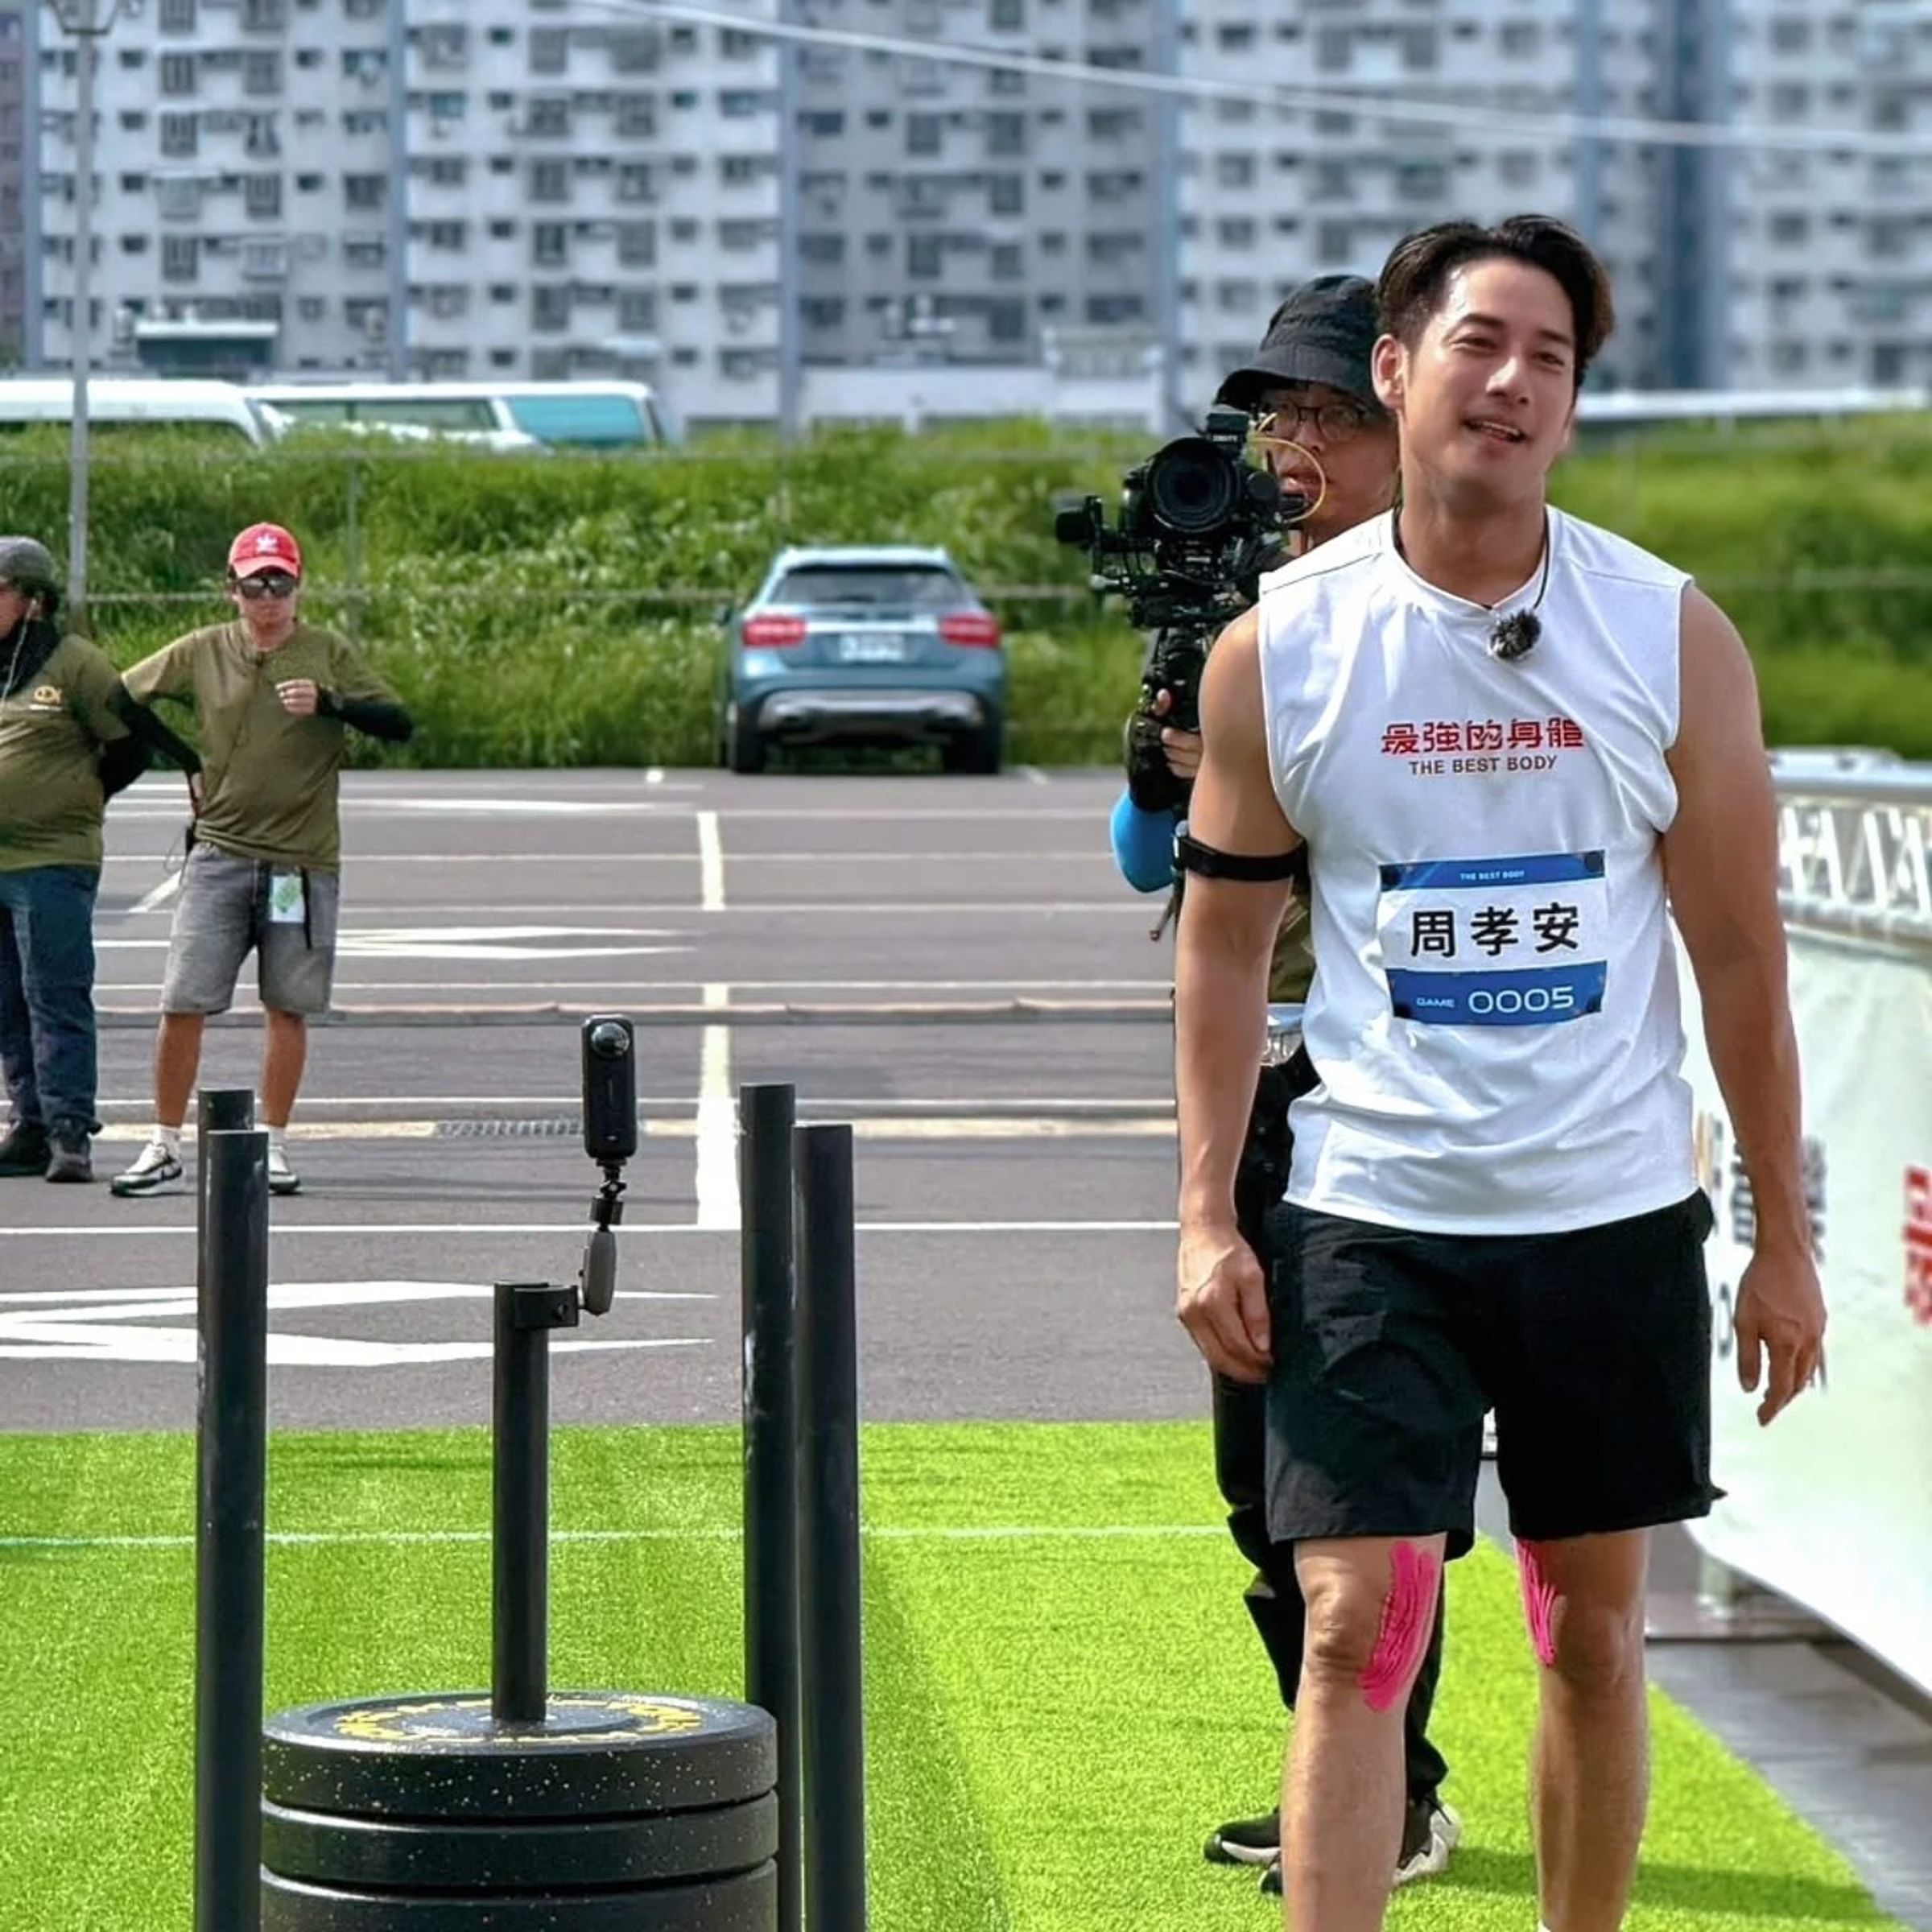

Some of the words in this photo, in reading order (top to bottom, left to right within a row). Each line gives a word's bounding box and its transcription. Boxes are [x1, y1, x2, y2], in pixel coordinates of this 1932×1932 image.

[1381, 717, 1584, 753] 最強的身體
[1409, 760, 1445, 774] THE
[1452, 758, 1500, 773] BEST
[1507, 755, 1558, 771] BODY
[1411, 902, 1579, 957] 周孝安
[1416, 997, 1455, 1008] GAME
[1468, 986, 1574, 1014] 0005
